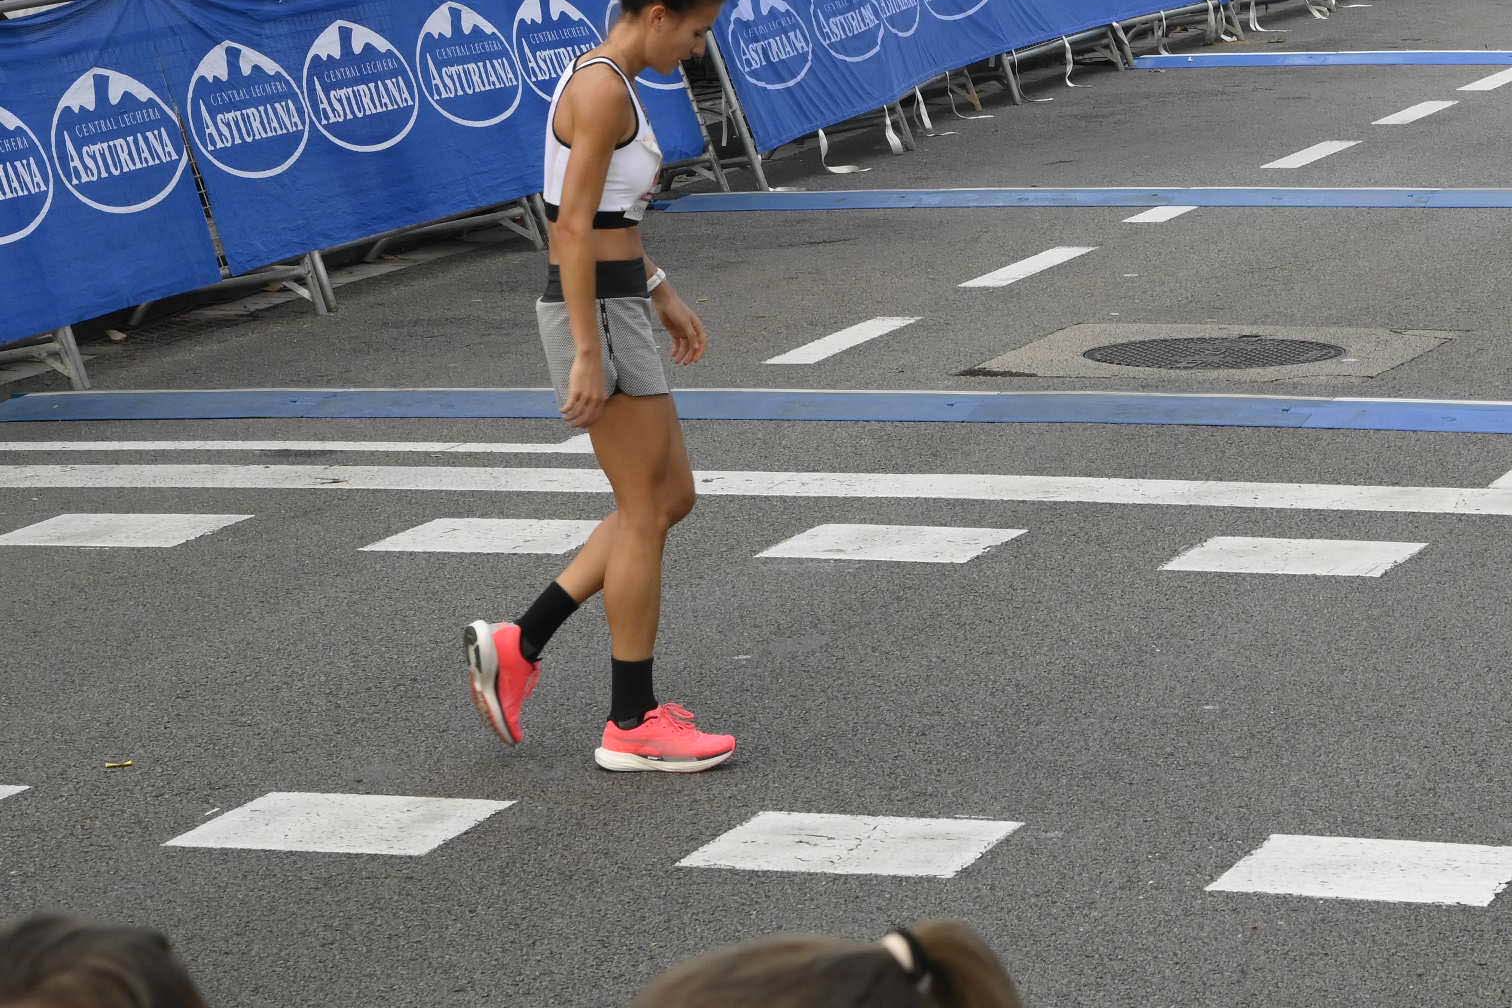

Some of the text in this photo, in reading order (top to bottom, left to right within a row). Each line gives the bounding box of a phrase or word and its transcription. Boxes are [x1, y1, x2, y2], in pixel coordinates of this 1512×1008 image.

[210, 80, 287, 106] CENTRAL LECHERA
[324, 58, 398, 83] CENTRAL LECHERA
[426, 52, 517, 101] ASTURIANA
[75, 107, 161, 139] CENTRAL LECHERA
[200, 98, 303, 151] ASTURIANA
[313, 75, 413, 125] ASTURIANA
[63, 127, 178, 186] ASTURIANA
